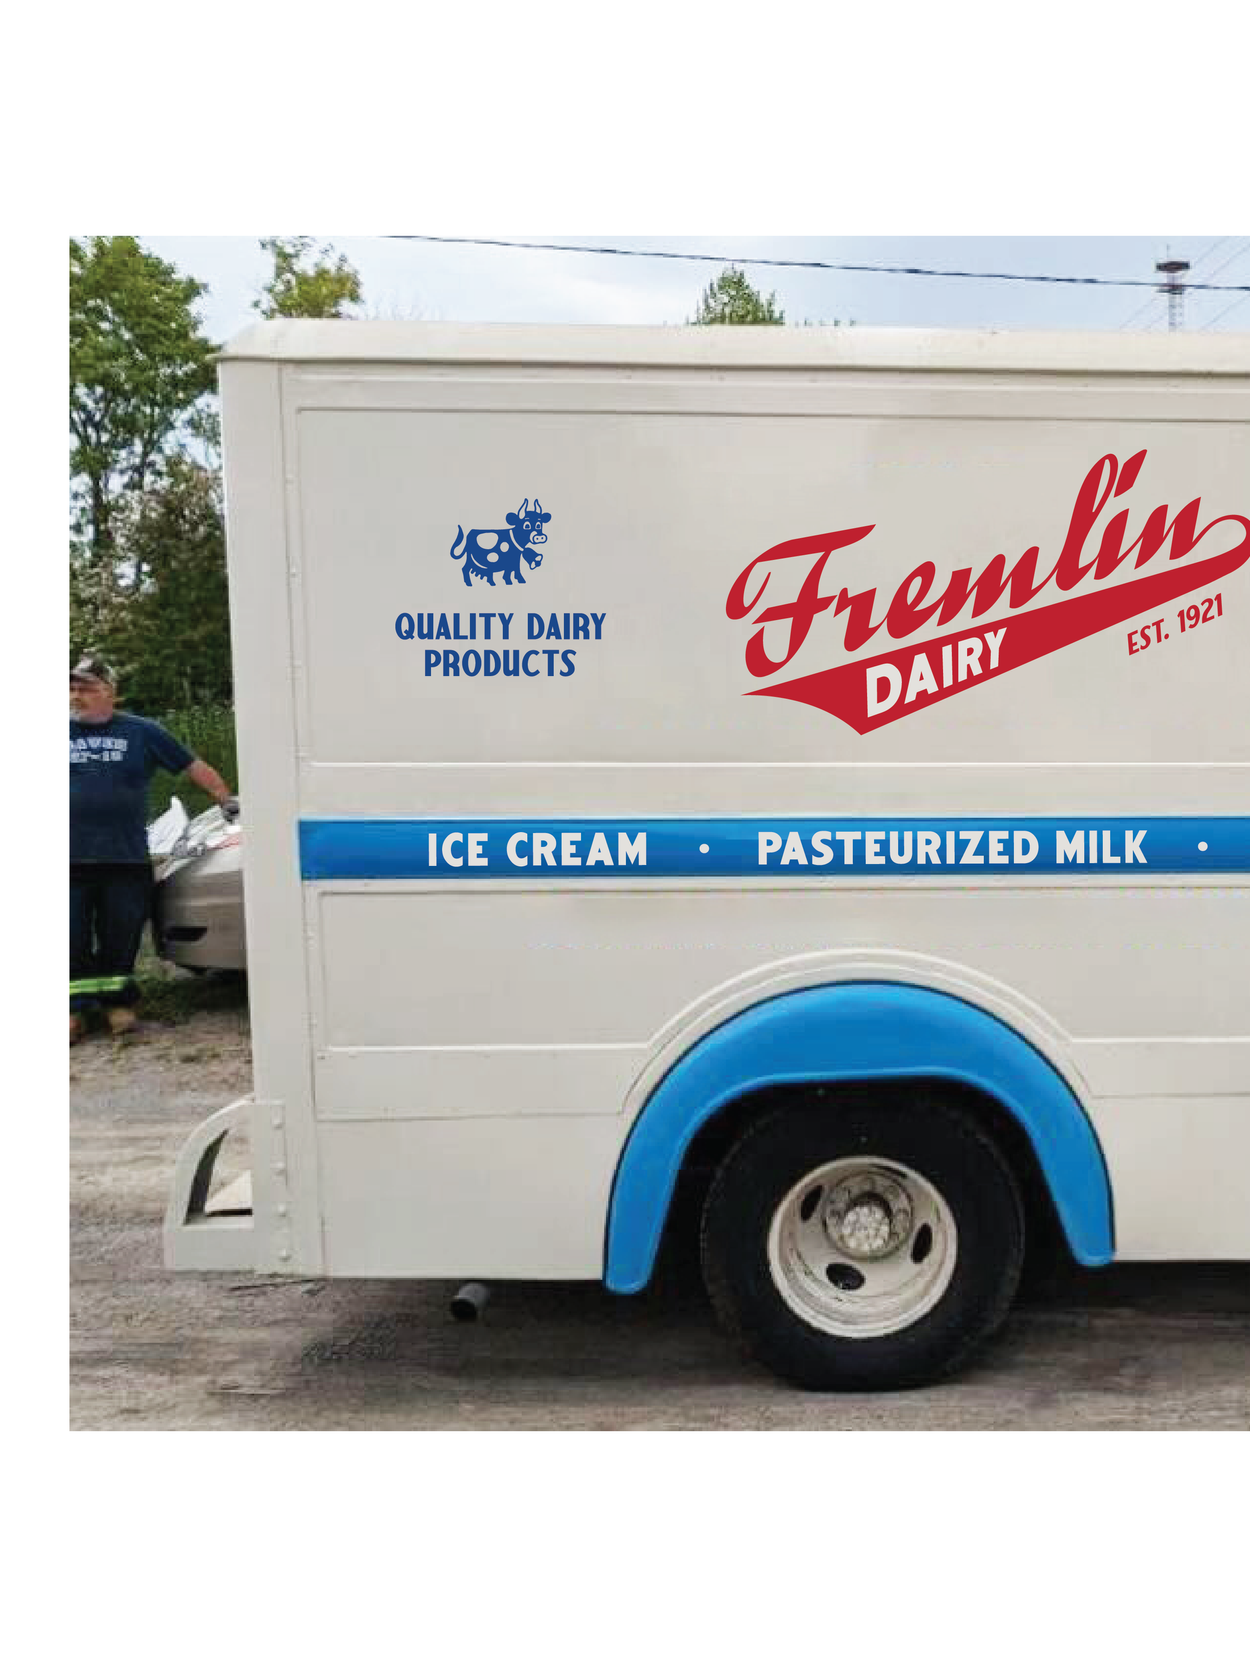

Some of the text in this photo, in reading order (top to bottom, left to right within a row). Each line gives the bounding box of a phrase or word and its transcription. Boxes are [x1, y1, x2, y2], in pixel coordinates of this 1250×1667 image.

[725, 448, 1203, 678] Fremlin
[394, 612, 607, 641] QUALITY DAIRY
[1127, 592, 1223, 656] EST. 1921
[424, 649, 577, 677] PRODUCTS
[866, 627, 1008, 718] DAIRY
[428, 832, 489, 867] ICE
[506, 831, 648, 867] CREAM
[758, 830, 1039, 866] PASTEURIZED
[1056, 830, 1148, 864] MILK
